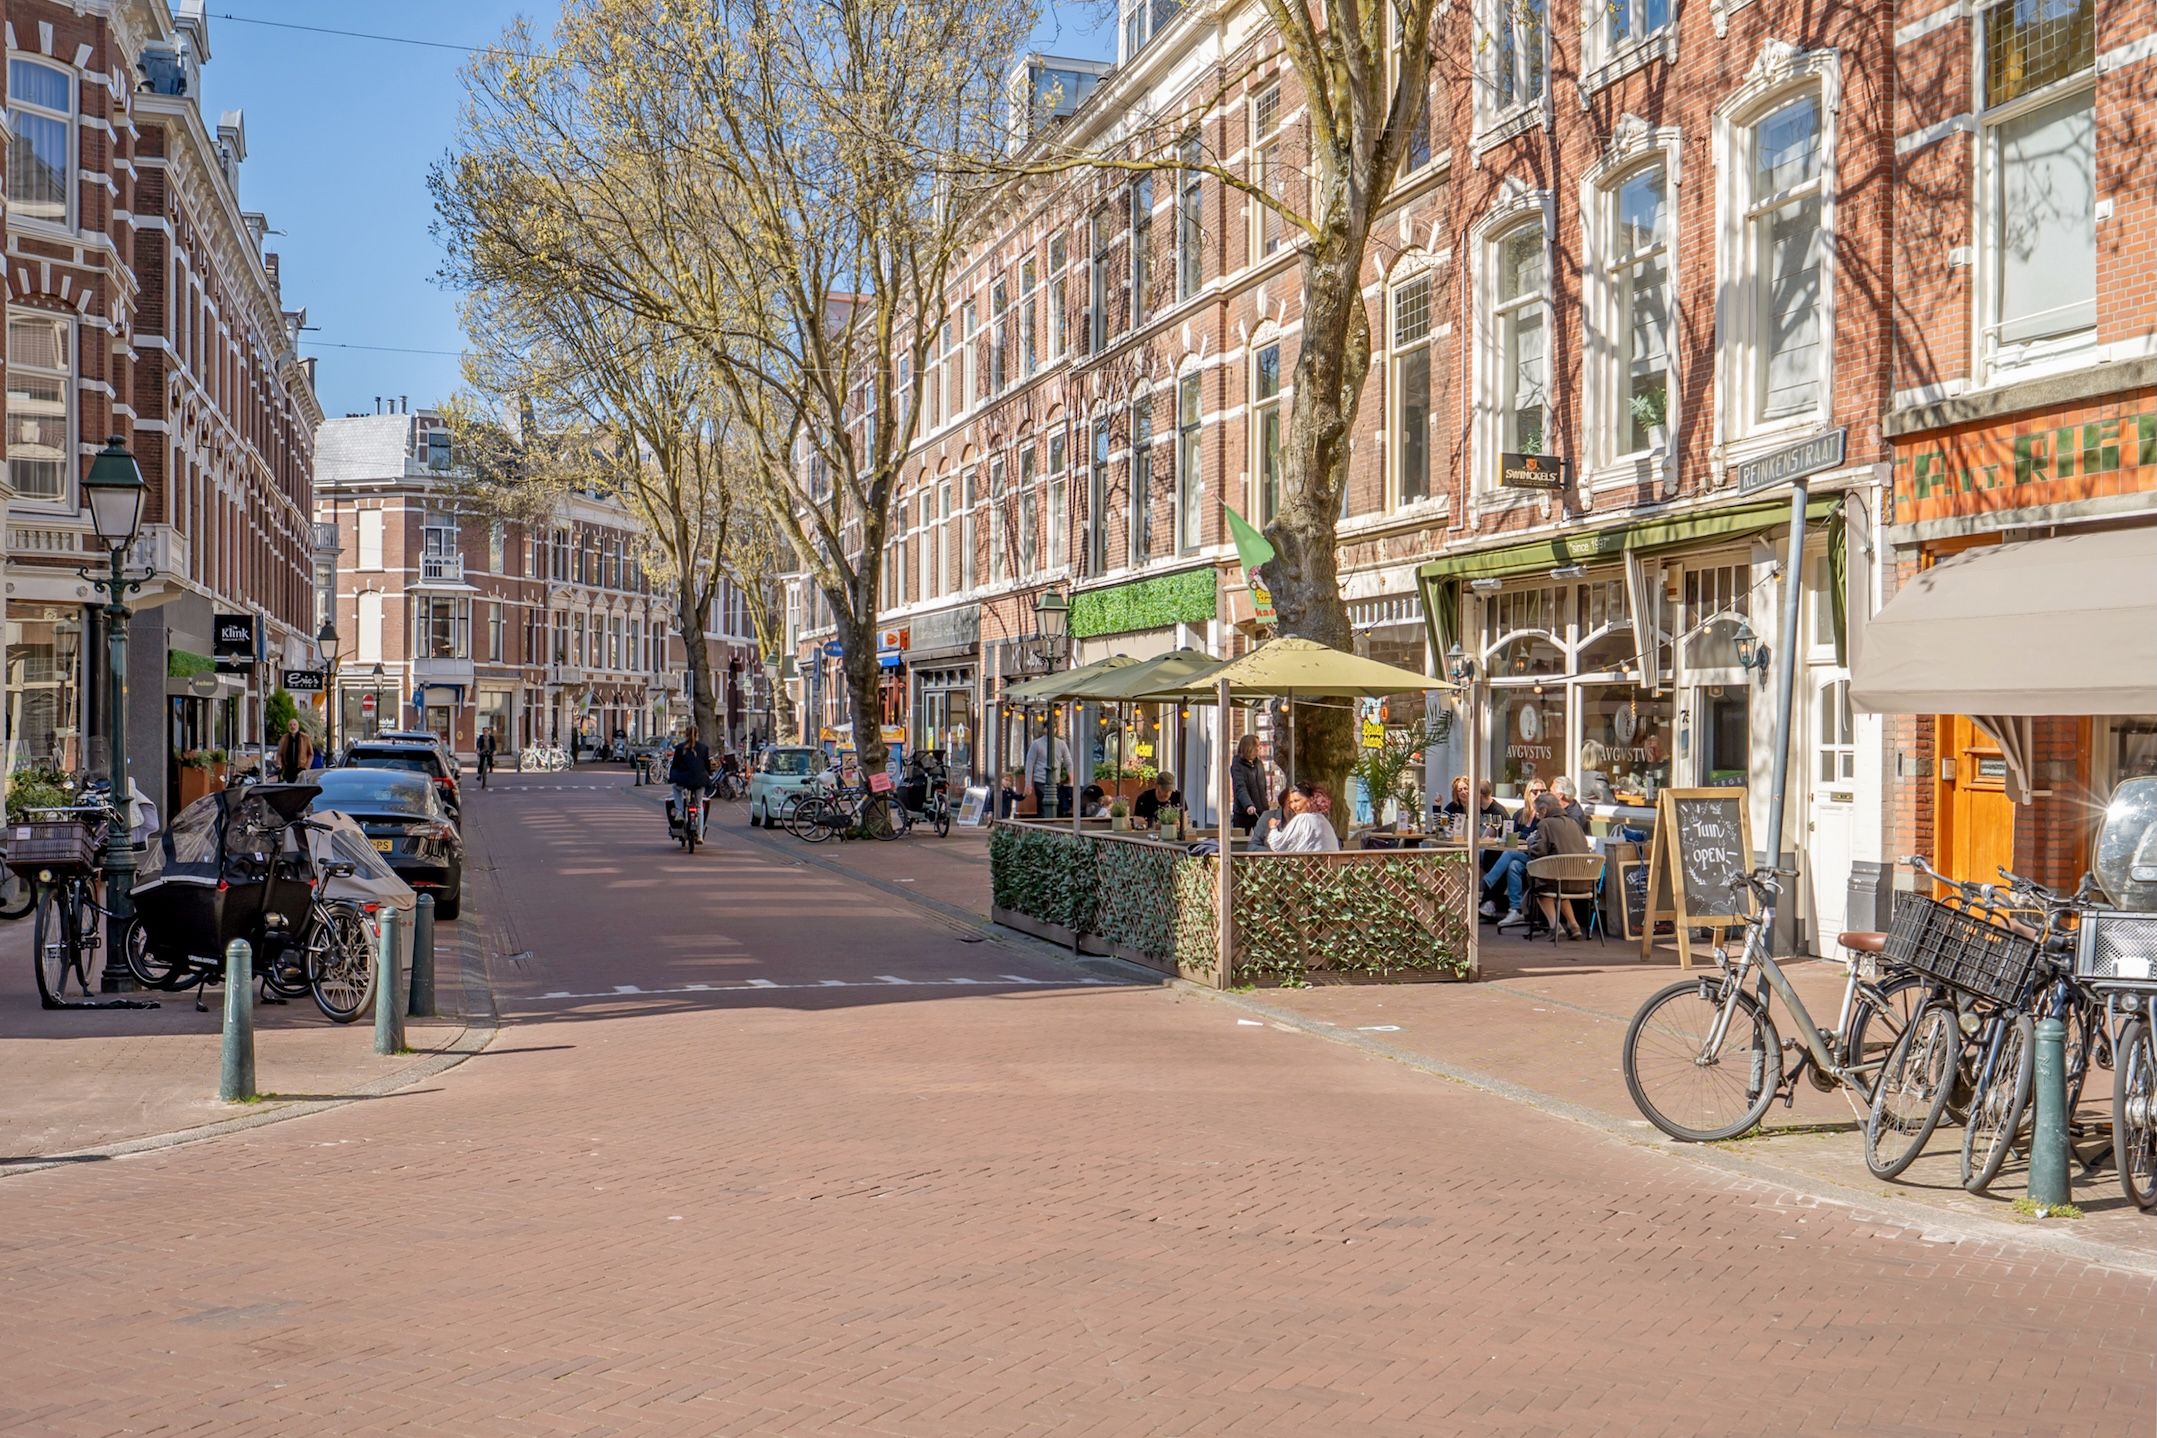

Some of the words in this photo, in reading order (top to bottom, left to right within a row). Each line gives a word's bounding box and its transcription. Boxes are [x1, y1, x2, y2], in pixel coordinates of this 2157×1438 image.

[1743, 436, 1836, 489] REINKENSTRAAT
[221, 627, 250, 640] Klink
[287, 672, 320, 685] Eric's
[1506, 744, 1552, 760] AVGVSTVS
[1600, 747, 1654, 762] AVGVSTVS
[1692, 847, 1726, 871] OPEN
